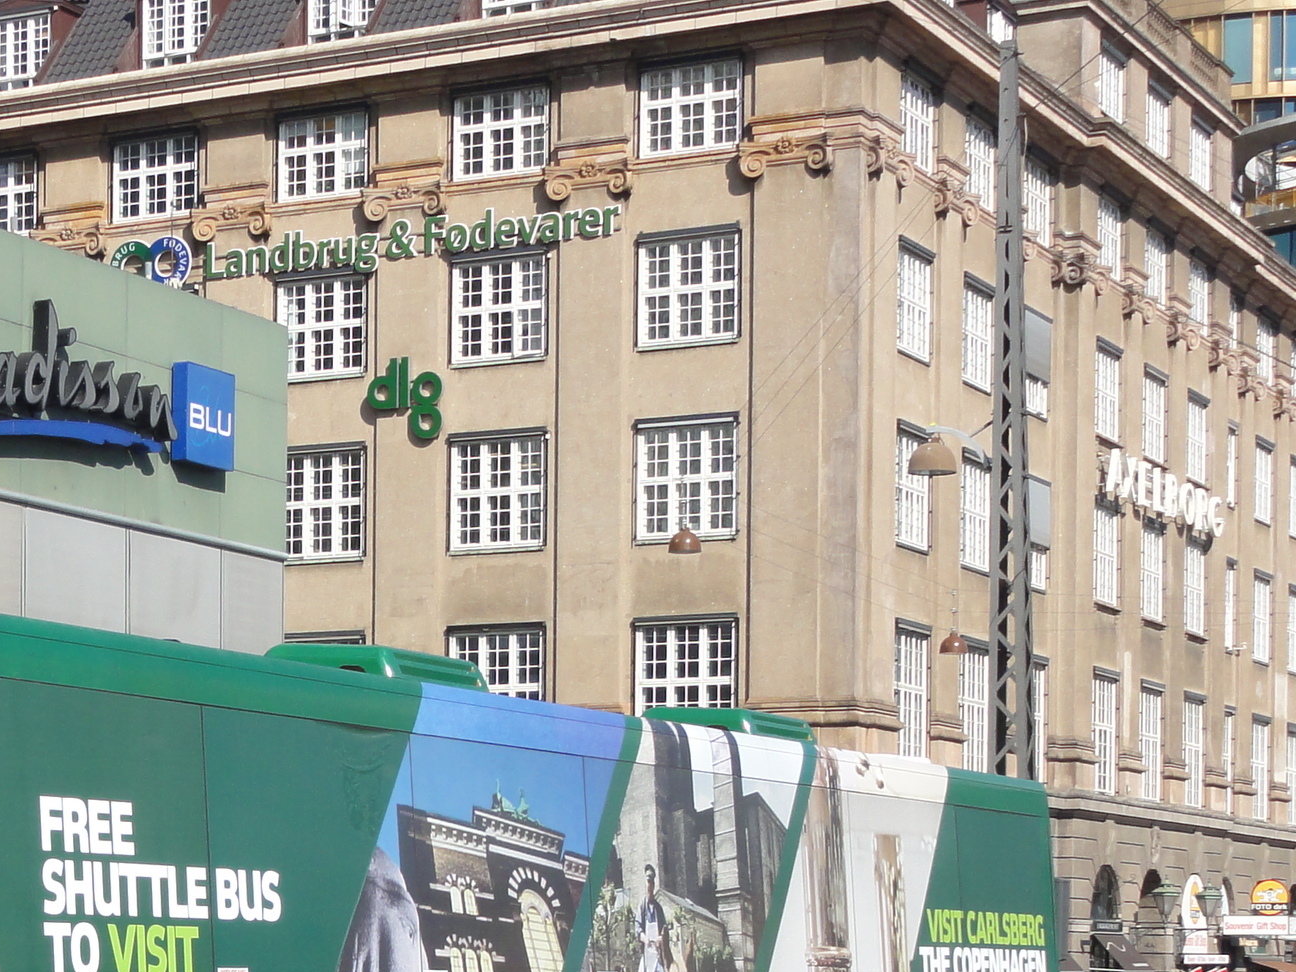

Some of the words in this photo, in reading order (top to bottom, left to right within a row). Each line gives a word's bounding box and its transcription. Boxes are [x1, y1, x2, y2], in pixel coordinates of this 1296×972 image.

[112, 242, 135, 267] BRUG
[205, 230, 380, 279] Landbrug
[386, 218, 419, 259] &
[423, 203, 622, 256] Fødevarer
[189, 402, 232, 437] BLU
[366, 355, 443, 439] dlg
[1105, 448, 1225, 537] AXELBORG
[39, 795, 135, 856] FREE
[42, 859, 209, 919] SHUTTLE
[216, 870, 282, 922] BUS
[926, 908, 963, 943] VISIT
[966, 911, 1045, 946] CARLSBERG
[1270, 921, 1287, 931] Shop
